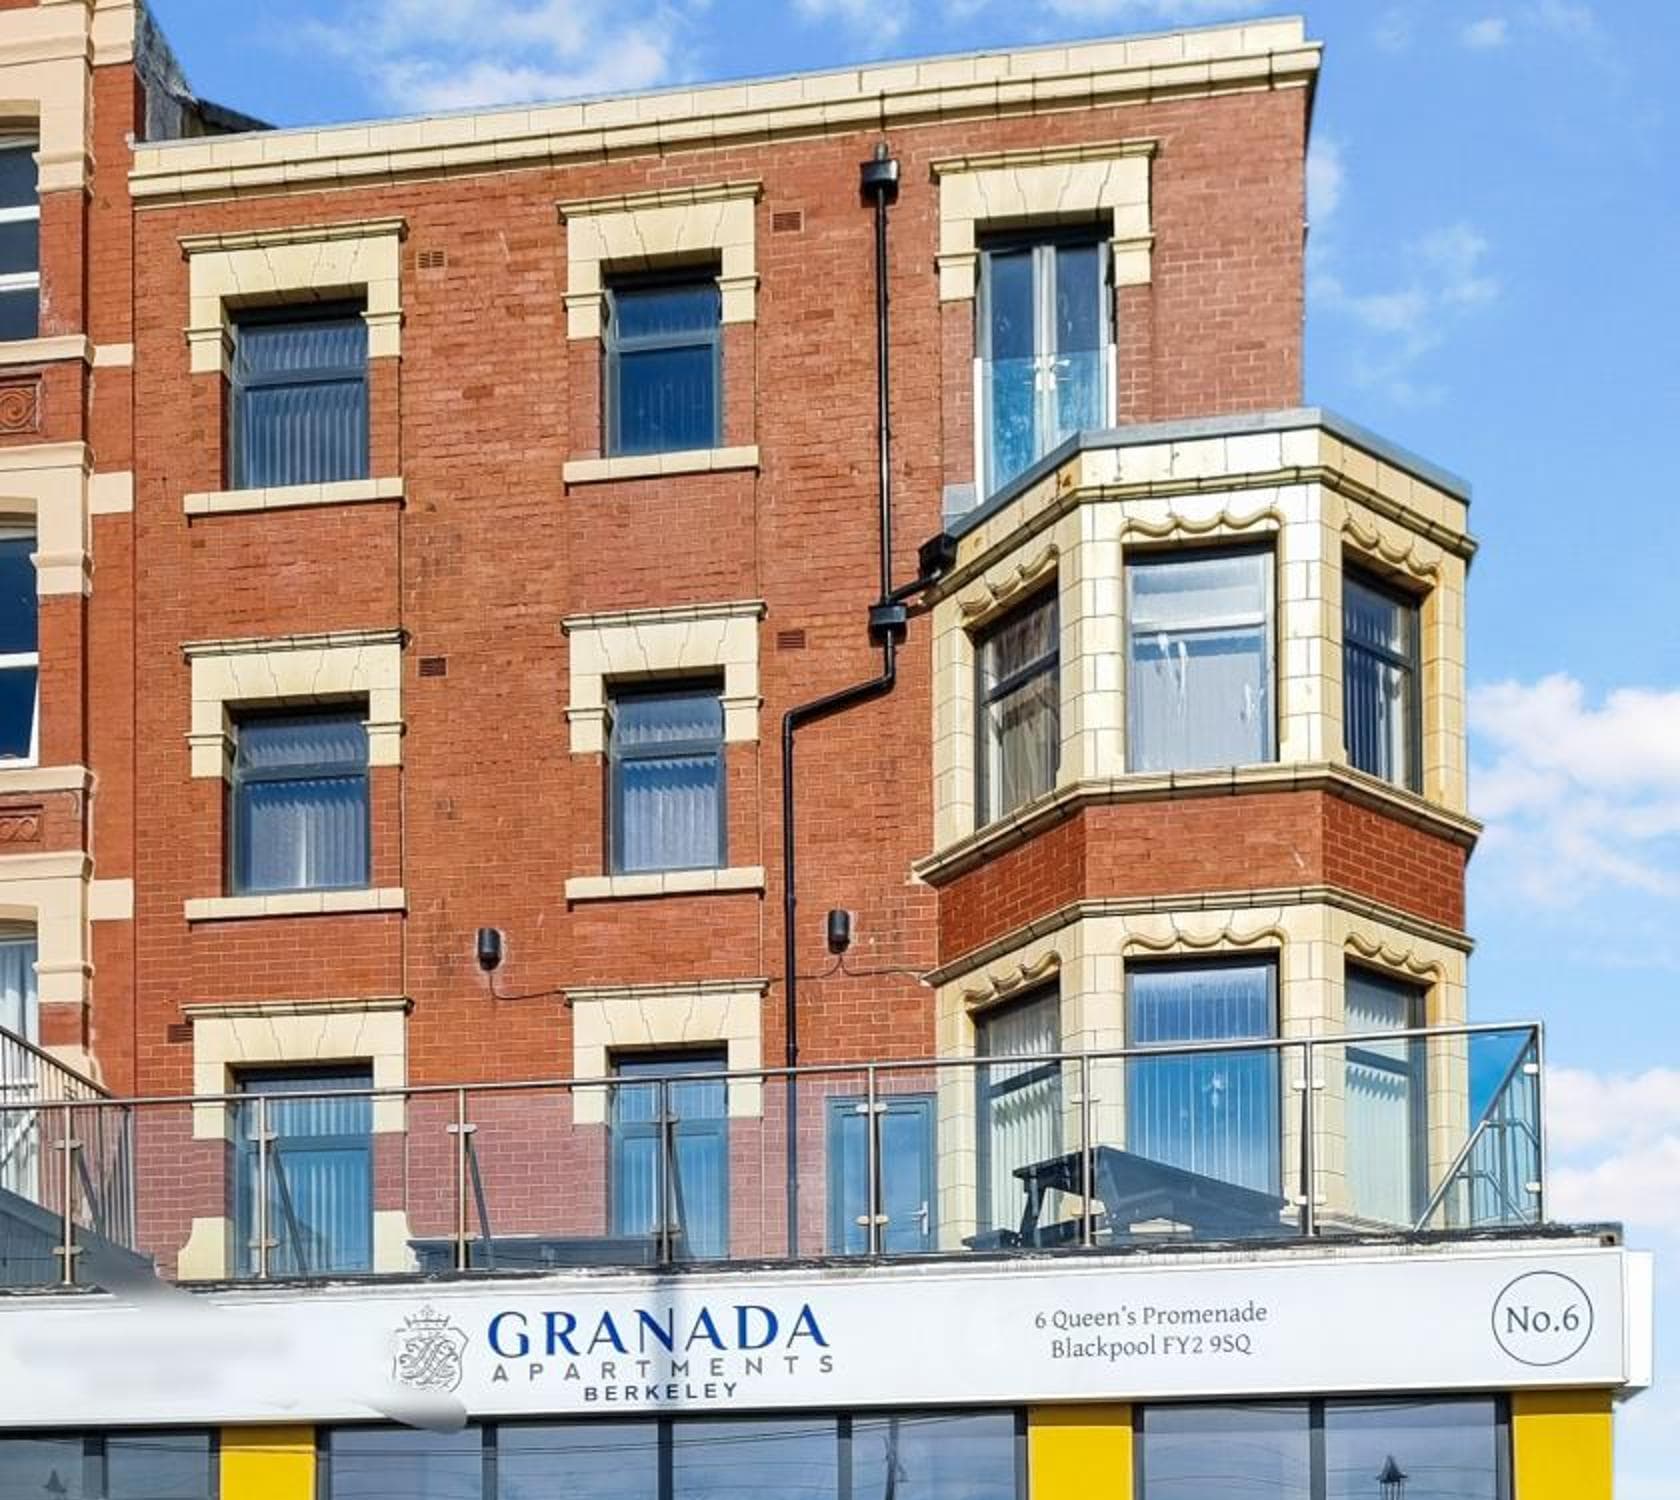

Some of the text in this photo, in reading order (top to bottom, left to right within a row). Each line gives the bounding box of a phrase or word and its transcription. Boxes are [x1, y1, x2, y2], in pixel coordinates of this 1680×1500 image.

[1035, 1300, 1267, 1330] 6 Queen's Promenade
[1506, 1303, 1579, 1333] No.6
[488, 1303, 829, 1358] GRANADA
[1052, 1333, 1253, 1362] Blackpool FY2 9SQ
[492, 1356, 834, 1382] APARTMENTS
[585, 1383, 738, 1401] BERKELEY
